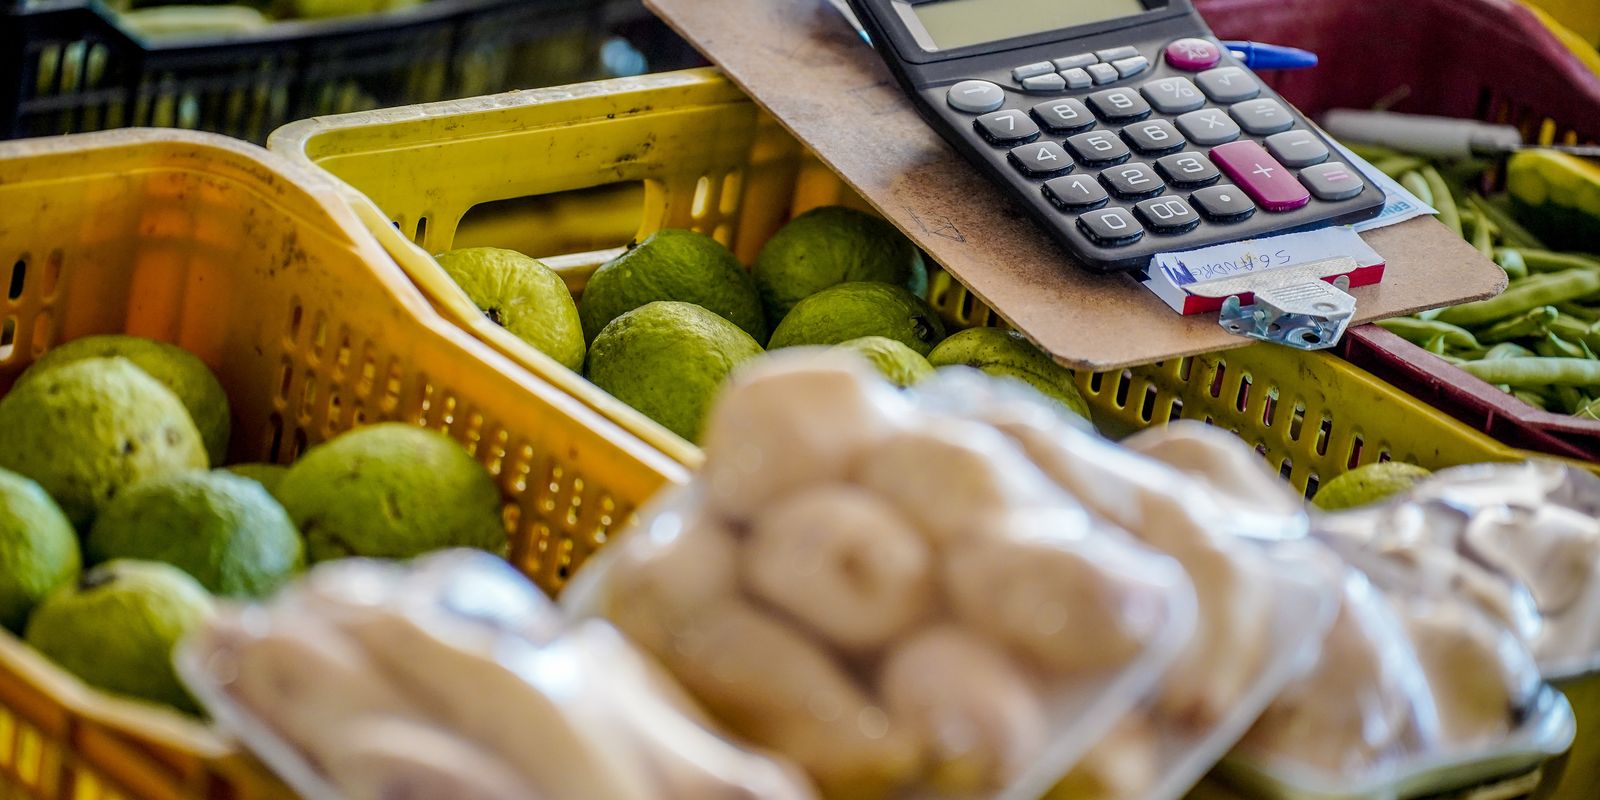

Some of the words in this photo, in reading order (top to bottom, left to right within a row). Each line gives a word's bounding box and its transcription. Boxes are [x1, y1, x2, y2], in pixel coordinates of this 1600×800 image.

[995, 115, 1014, 131] 7
[1052, 104, 1078, 120] 8
[1107, 93, 1134, 109] 9
[1036, 147, 1057, 161] 4
[1087, 135, 1113, 151] 5
[1143, 125, 1169, 141] 6
[1071, 180, 1090, 195] 1
[1121, 169, 1150, 185] 2
[1176, 157, 1204, 173] 3
[1101, 213, 1127, 230] 0
[1150, 200, 1189, 219] 00
